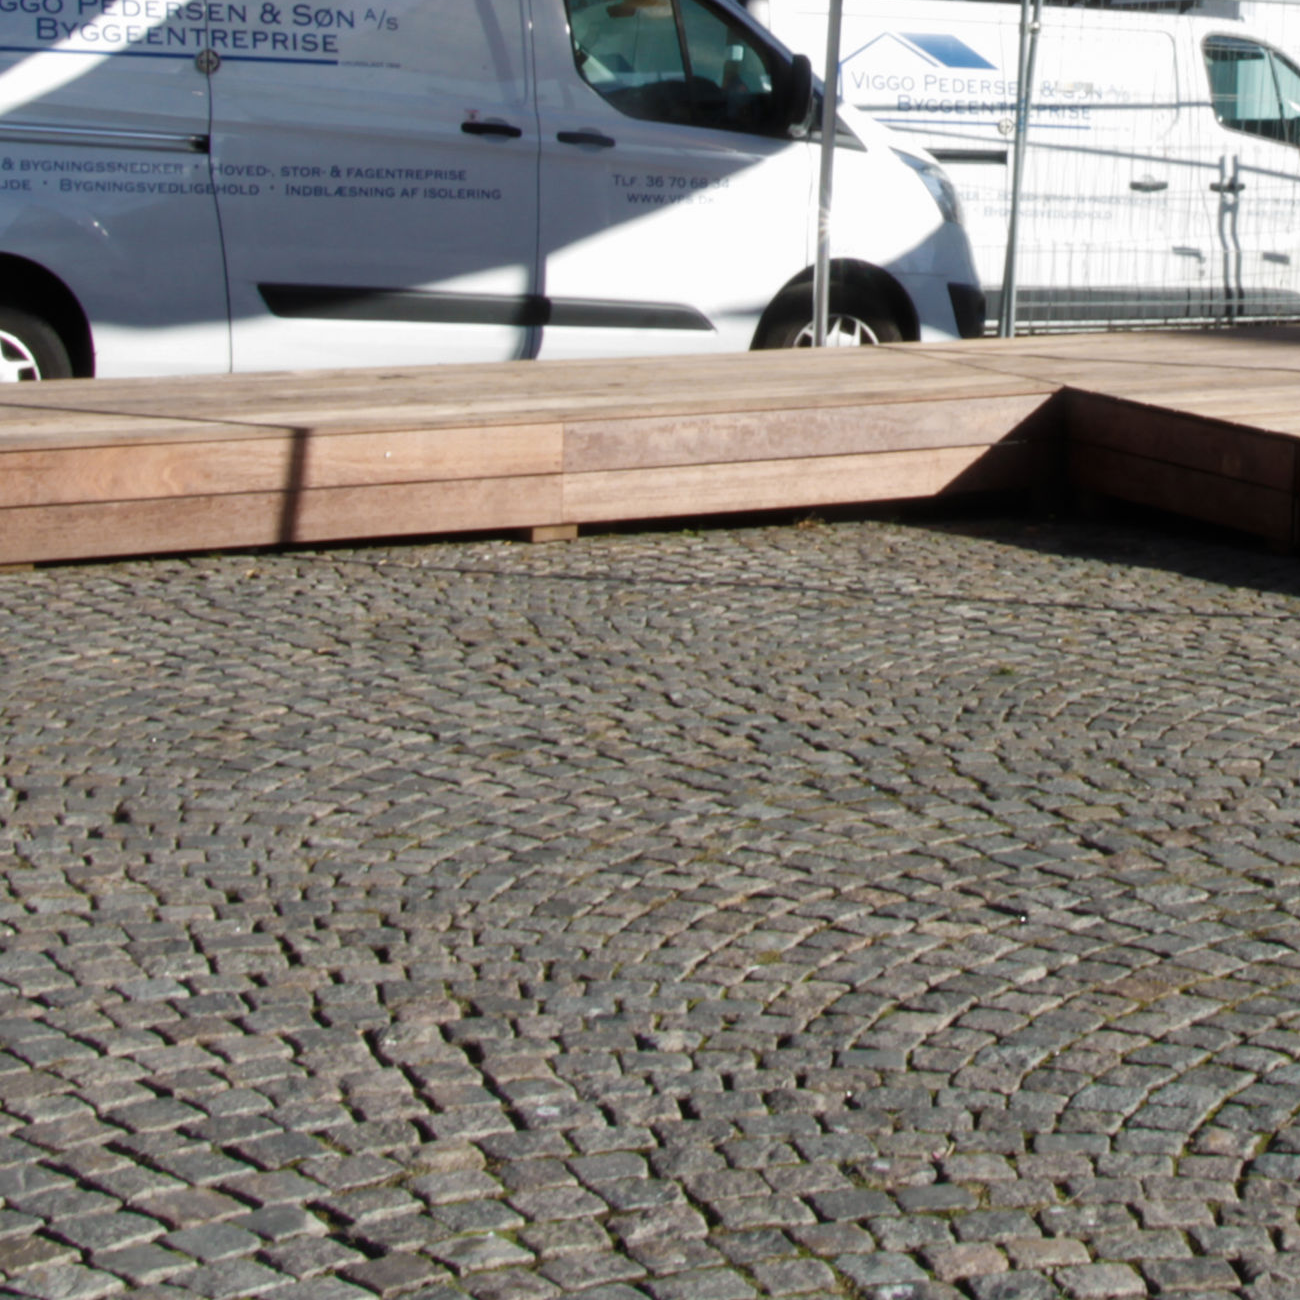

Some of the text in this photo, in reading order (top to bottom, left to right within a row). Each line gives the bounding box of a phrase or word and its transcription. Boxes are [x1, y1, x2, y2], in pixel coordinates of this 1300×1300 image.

[260, 2, 281, 25] &
[292, 3, 355, 29] SØN
[364, 8, 399, 31] A/S
[36, 17, 338, 53] BYGGEENTREPRISE
[851, 71, 915, 92] VIGGO
[924, 74, 1020, 96] PEDERSE
[897, 94, 1092, 120] BYGGEENTRPRISE
[1, 158, 14, 171] &
[20, 159, 184, 174] BYGNINGSSNEDKER
[280, 165, 326, 178] STOR-
[330, 165, 341, 178] &
[346, 167, 467, 181] FAGENTREPRISE
[645, 175, 665, 188] 36
[668, 176, 687, 189] 70
[59, 178, 260, 195] BYGNINGSVEDLIGEHOLD
[285, 183, 396, 198] INDBLÆSNING
[400, 187, 418, 199] AF
[423, 187, 502, 200] ISOLERING
